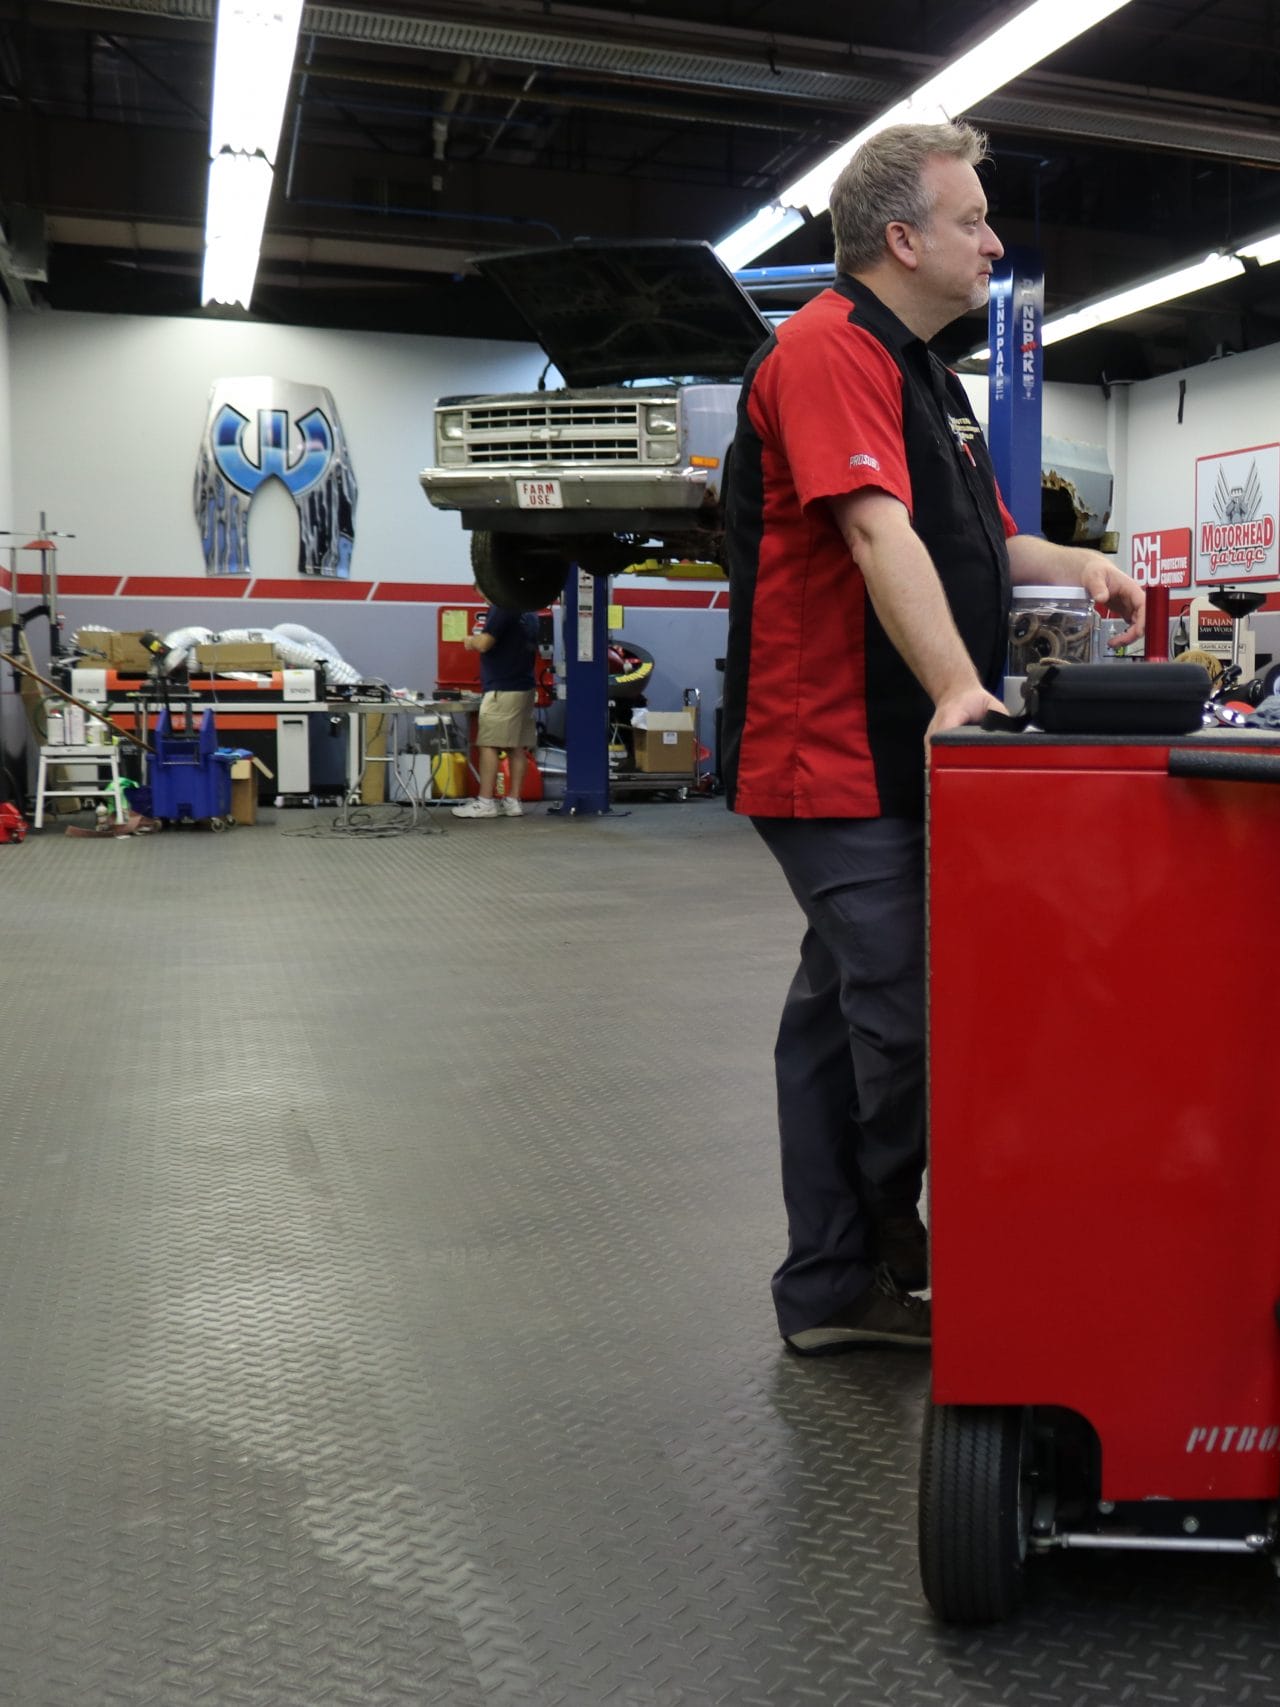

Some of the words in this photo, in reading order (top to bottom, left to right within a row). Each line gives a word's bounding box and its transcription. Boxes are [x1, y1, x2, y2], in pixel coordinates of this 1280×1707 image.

[523, 483, 554, 494] FARM
[530, 495, 550, 505] USE
[1202, 517, 1274, 553] MOTORHEAD
[1210, 547, 1266, 572] garage
[1200, 616, 1233, 627] TRAJAN
